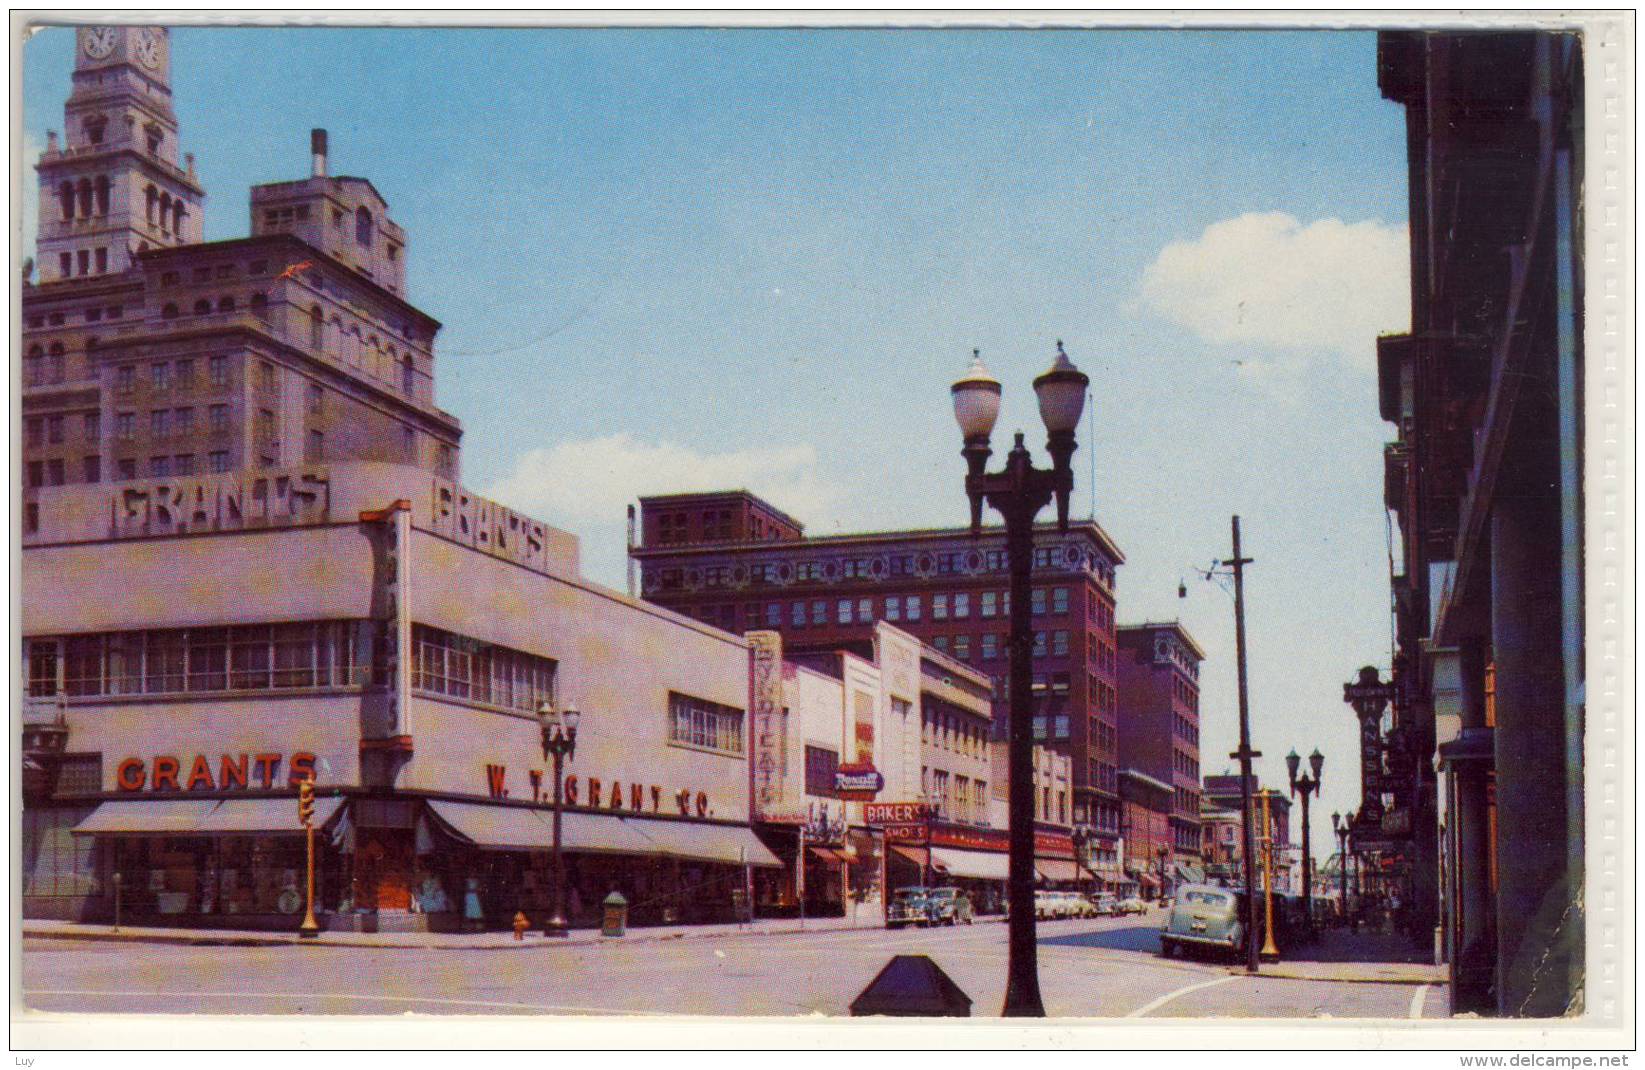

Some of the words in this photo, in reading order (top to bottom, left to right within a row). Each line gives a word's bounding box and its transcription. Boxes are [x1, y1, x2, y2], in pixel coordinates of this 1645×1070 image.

[111, 474, 330, 538] GRANTS
[117, 752, 317, 791] GRANTS
[486, 764, 508, 799] W.
[529, 770, 548, 801] T.
[564, 774, 662, 813] GRANT
